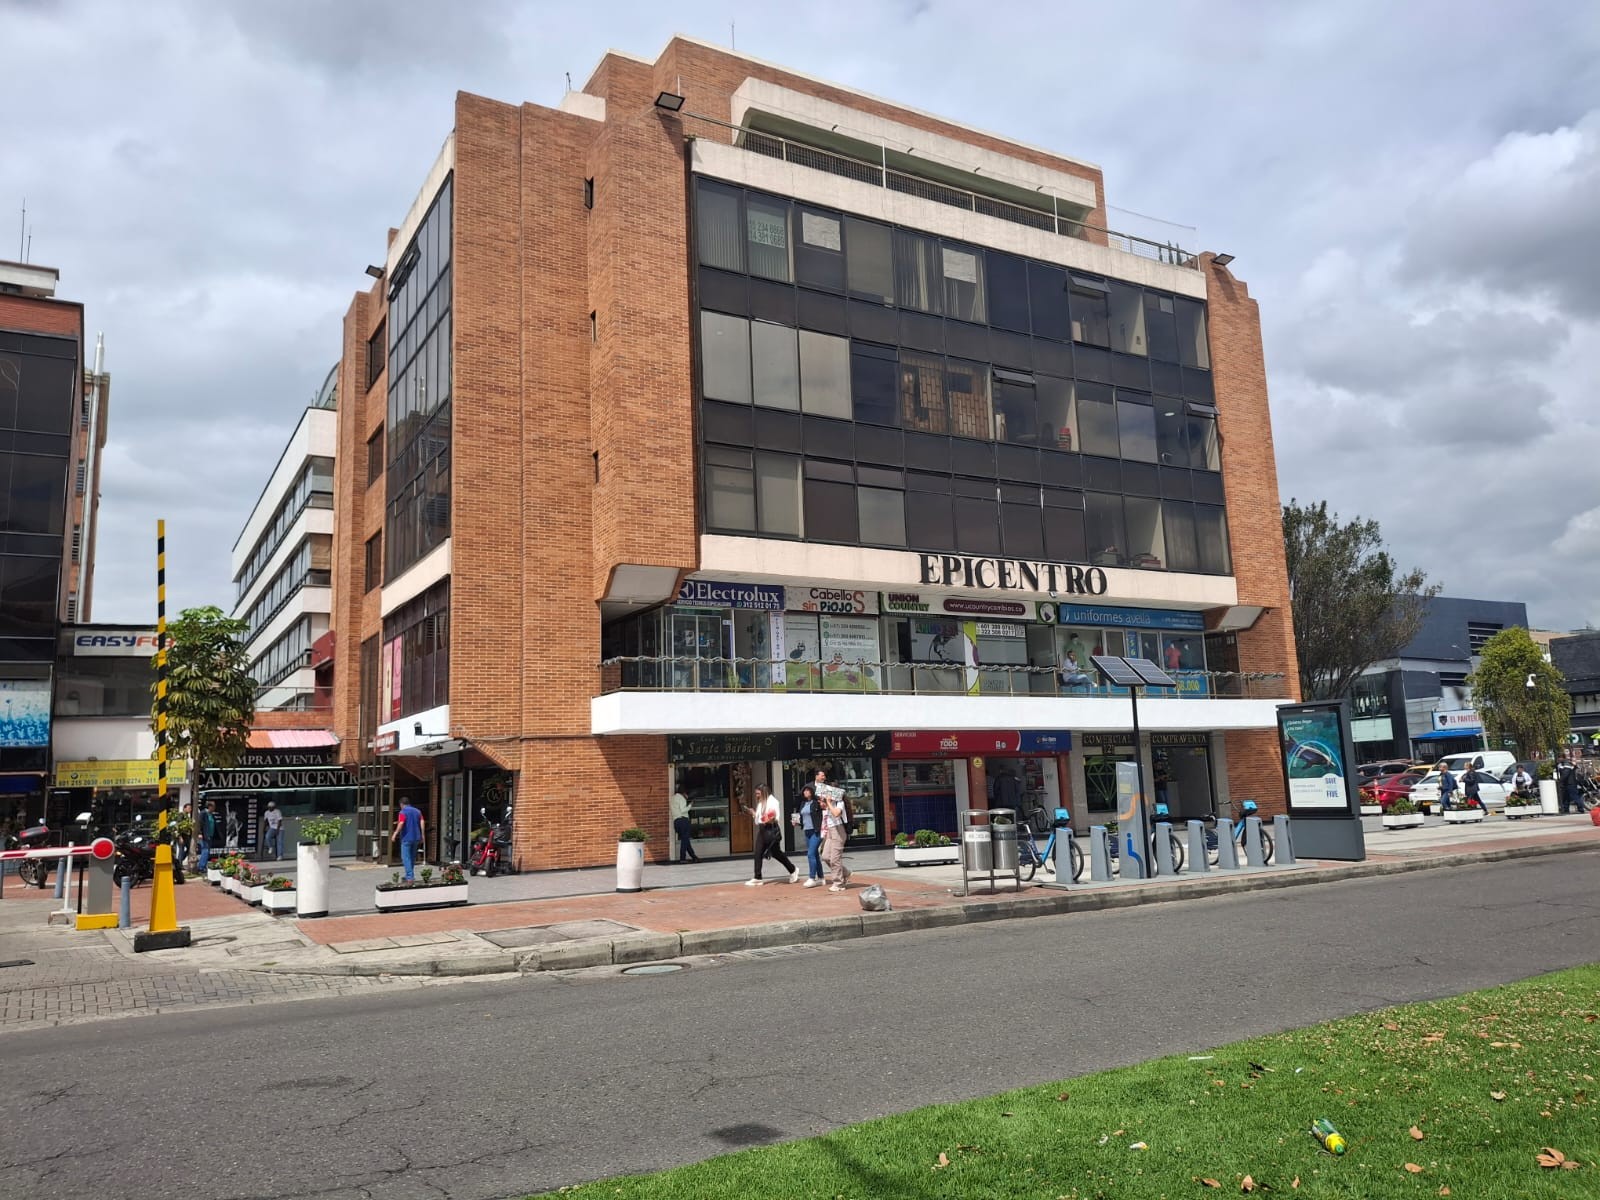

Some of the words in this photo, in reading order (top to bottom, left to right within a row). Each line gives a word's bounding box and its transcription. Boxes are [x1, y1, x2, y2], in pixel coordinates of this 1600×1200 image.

[919, 554, 1108, 595] EPICENTRO
[696, 582, 779, 602] Electrolux
[888, 593, 920, 602] UNION
[801, 600, 818, 611] sin
[888, 602, 930, 612] COUNTRY
[1073, 608, 1123, 623] uniformes
[797, 736, 856, 750] FENIX
[1152, 734, 1206, 744] COMPRAVENTA
[237, 755, 273, 766] MPRA
[275, 756, 284, 765] Y
[284, 755, 323, 765] VENTA
[199, 771, 271, 788] CAMBIOS
[277, 769, 359, 786] UNICENTR
